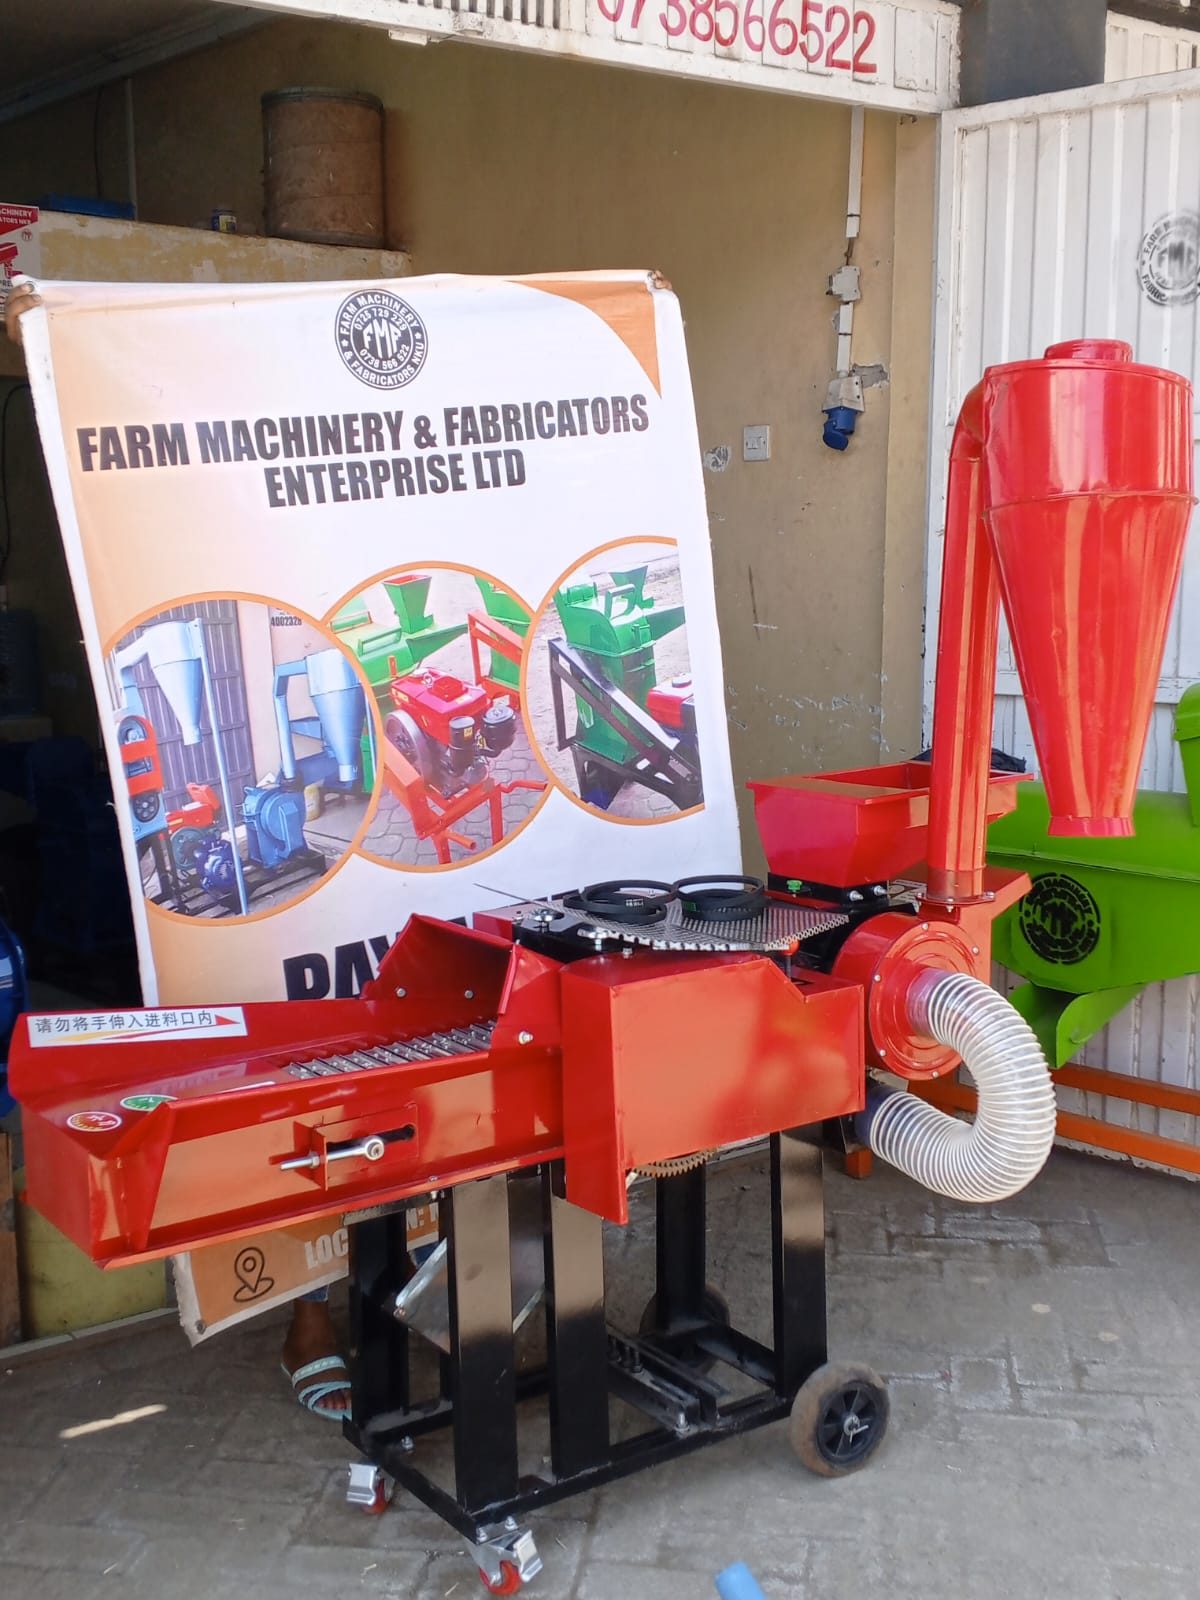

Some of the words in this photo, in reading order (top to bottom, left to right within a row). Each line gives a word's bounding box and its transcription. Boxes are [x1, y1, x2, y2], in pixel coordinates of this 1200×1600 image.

[0, 208, 33, 218] CHINERY
[340, 303, 358, 335] FARM
[357, 294, 419, 328] MACHINERY
[351, 360, 415, 386] FABRICATORS
[411, 341, 424, 365] NKU
[360, 348, 380, 368] 0738
[396, 344, 410, 362] 522
[77, 423, 190, 472] FARM
[196, 410, 404, 464] MACHINERY
[413, 415, 437, 448] &
[443, 394, 650, 447] FABRICATORS
[264, 450, 466, 508] ENTERPRISE
[475, 448, 526, 489] LTD
[35, 1010, 213, 1034] 请勿将手伸入进料口内
